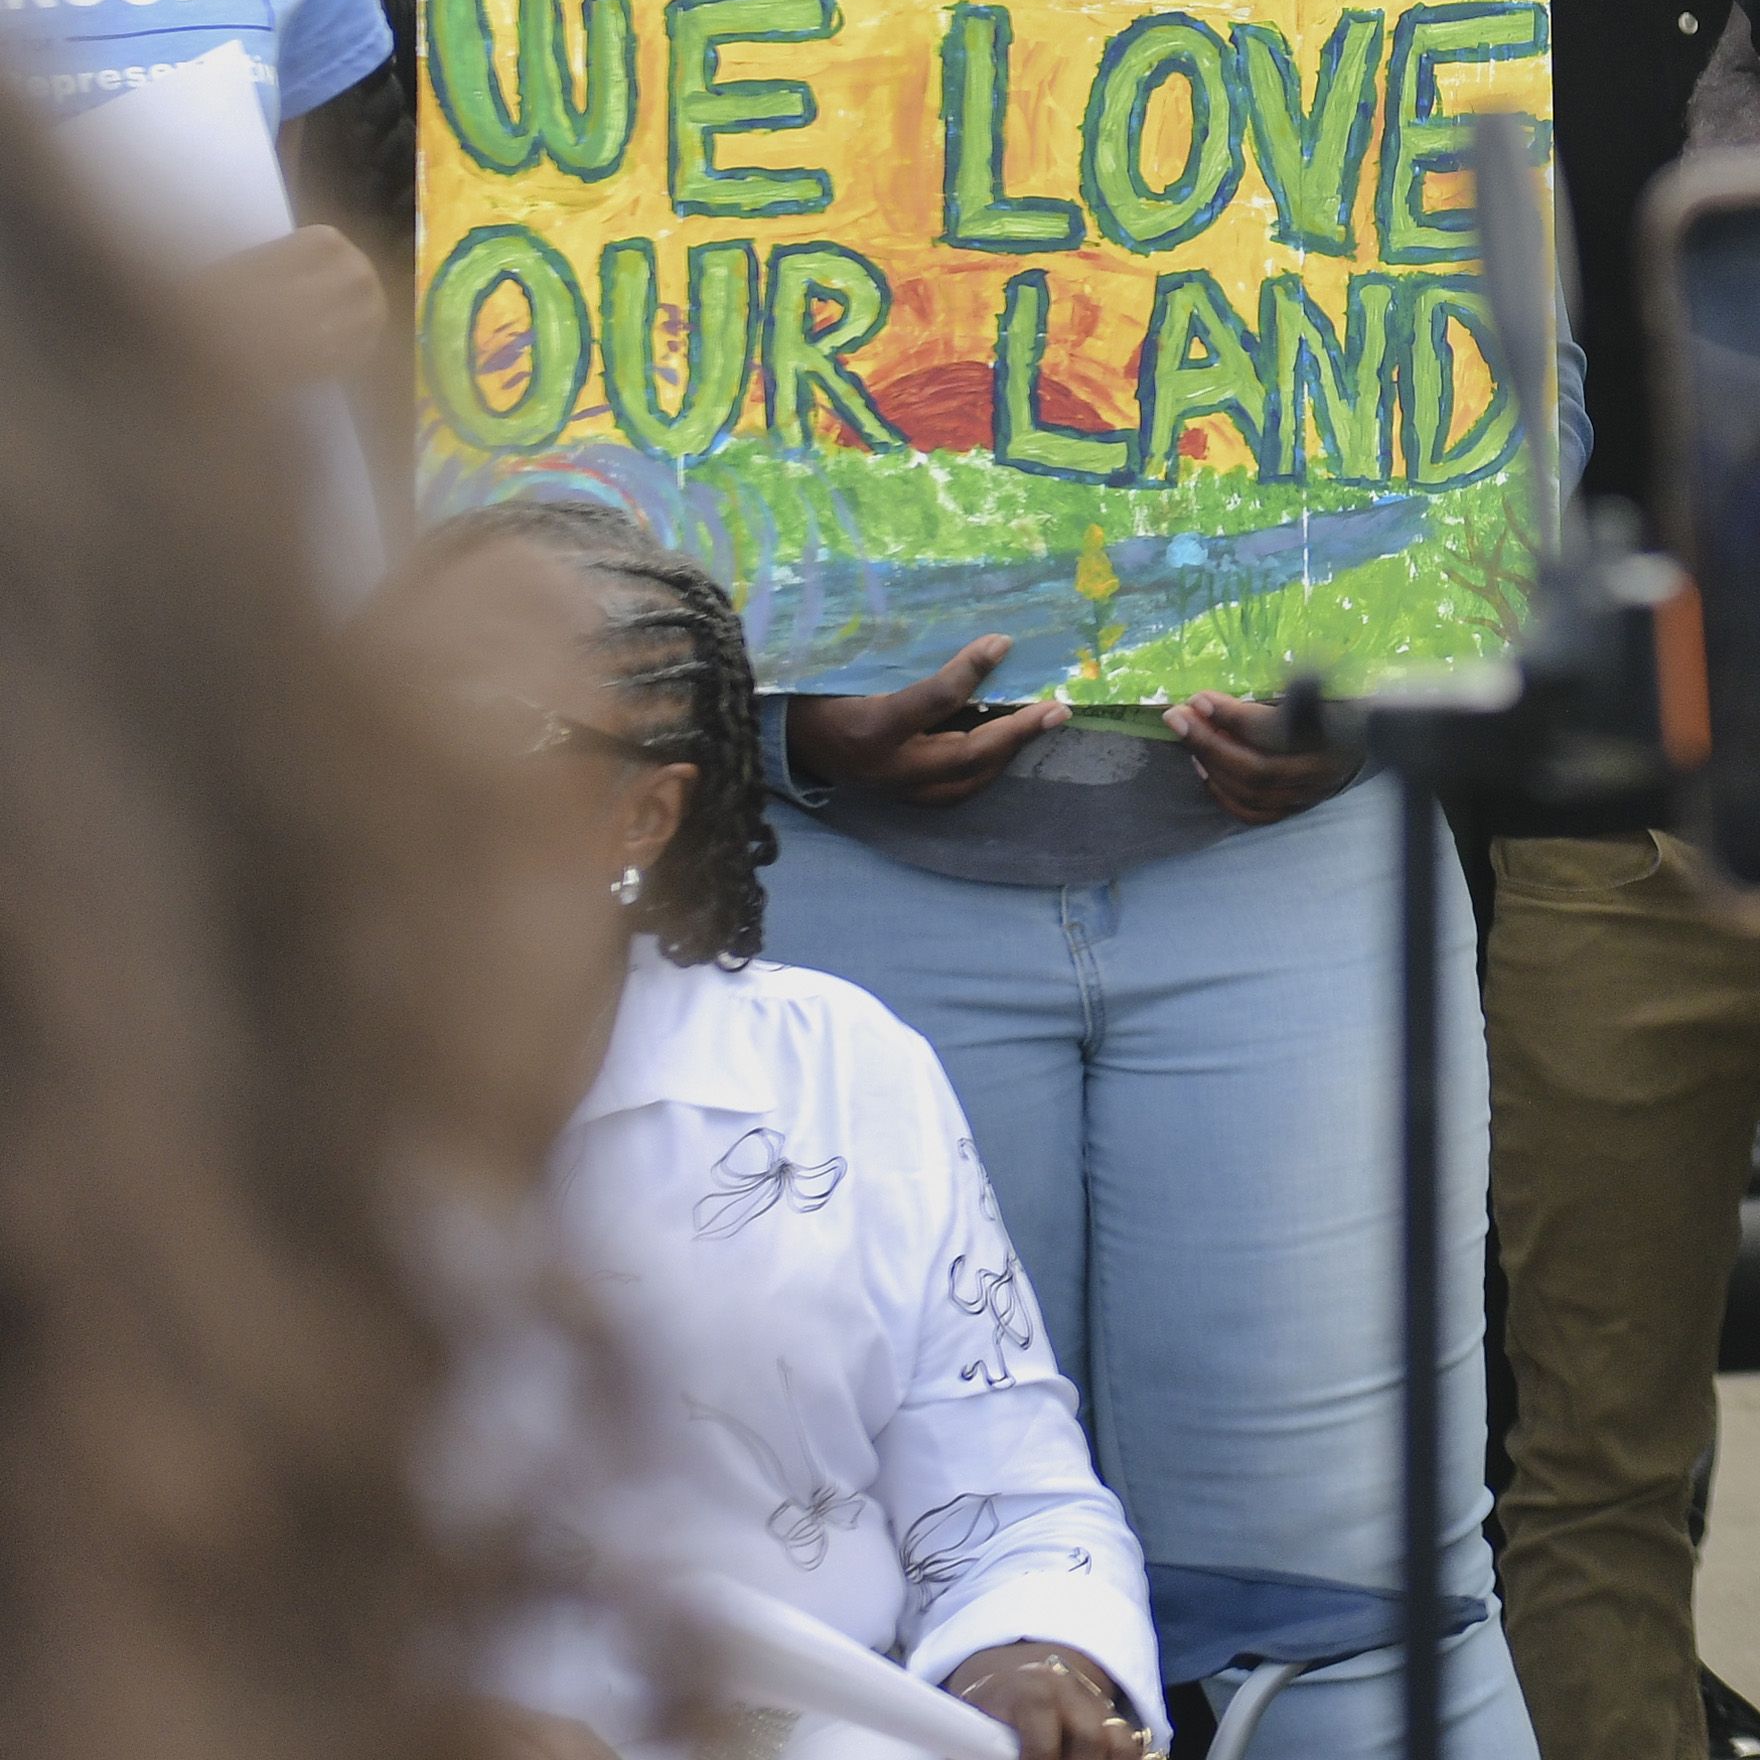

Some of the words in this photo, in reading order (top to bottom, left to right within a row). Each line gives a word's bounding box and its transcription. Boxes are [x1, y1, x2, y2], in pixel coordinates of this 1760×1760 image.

[936, 2, 1551, 264] LOVE
[423, 223, 909, 464] OUR
[993, 269, 1524, 490] LAND
